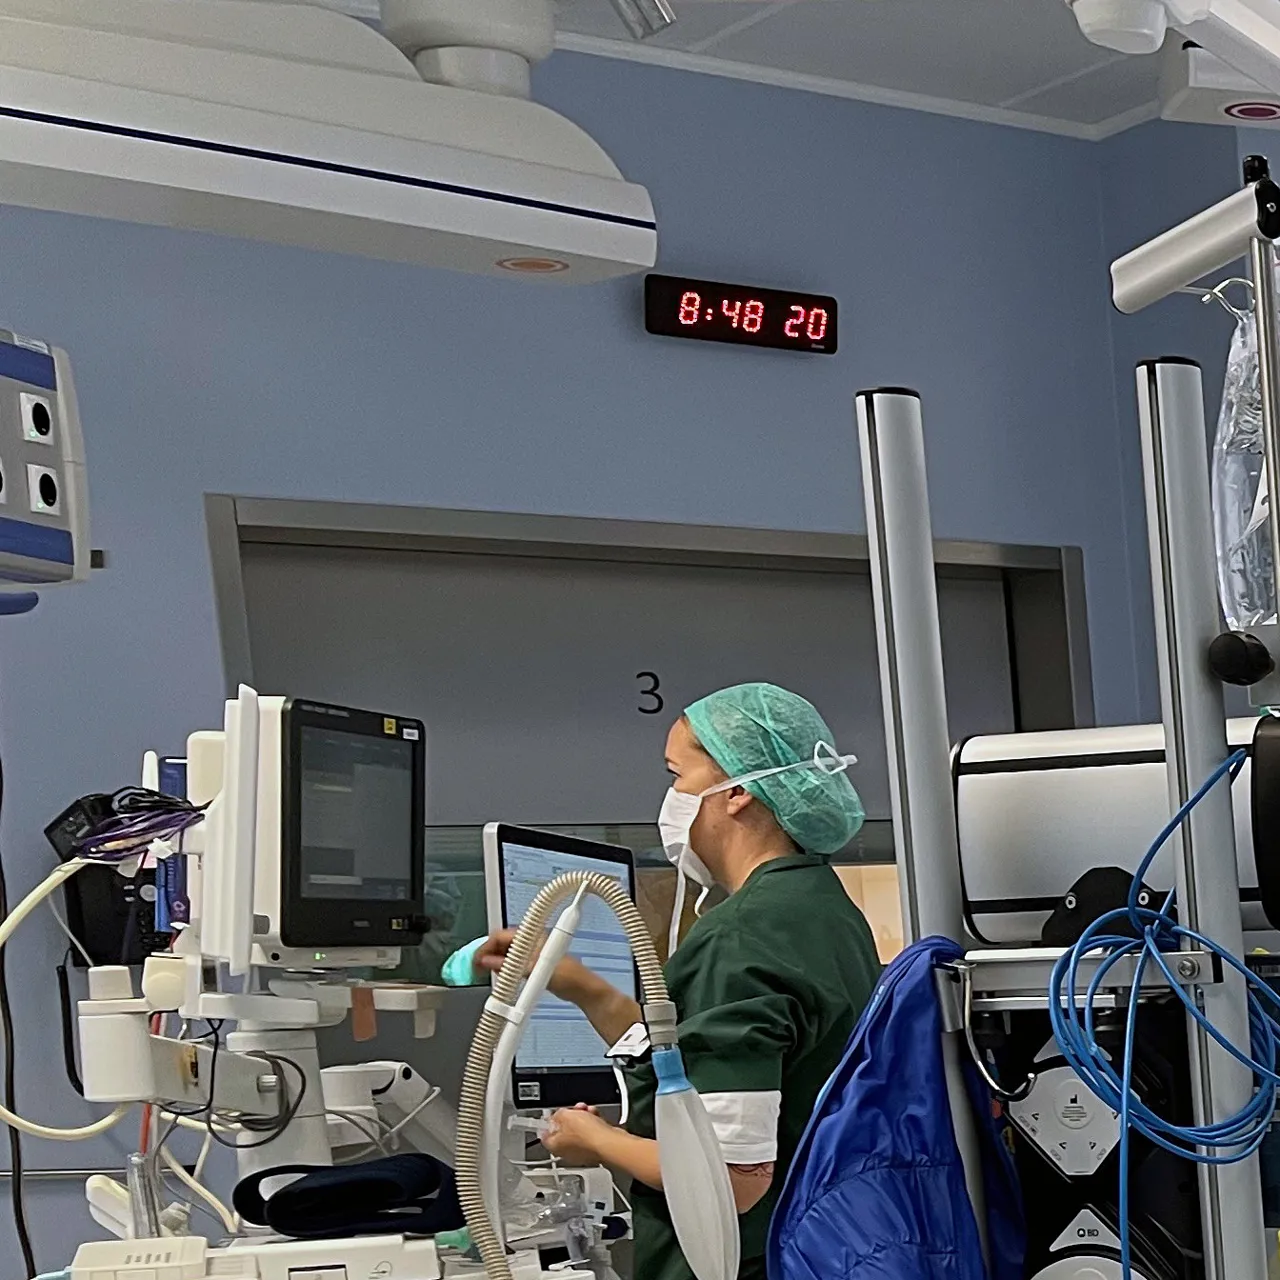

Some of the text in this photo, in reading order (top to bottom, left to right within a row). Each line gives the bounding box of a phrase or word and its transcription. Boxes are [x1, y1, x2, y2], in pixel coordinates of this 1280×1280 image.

[678, 291, 828, 340] 8:48 20
[636, 671, 664, 715] 3
